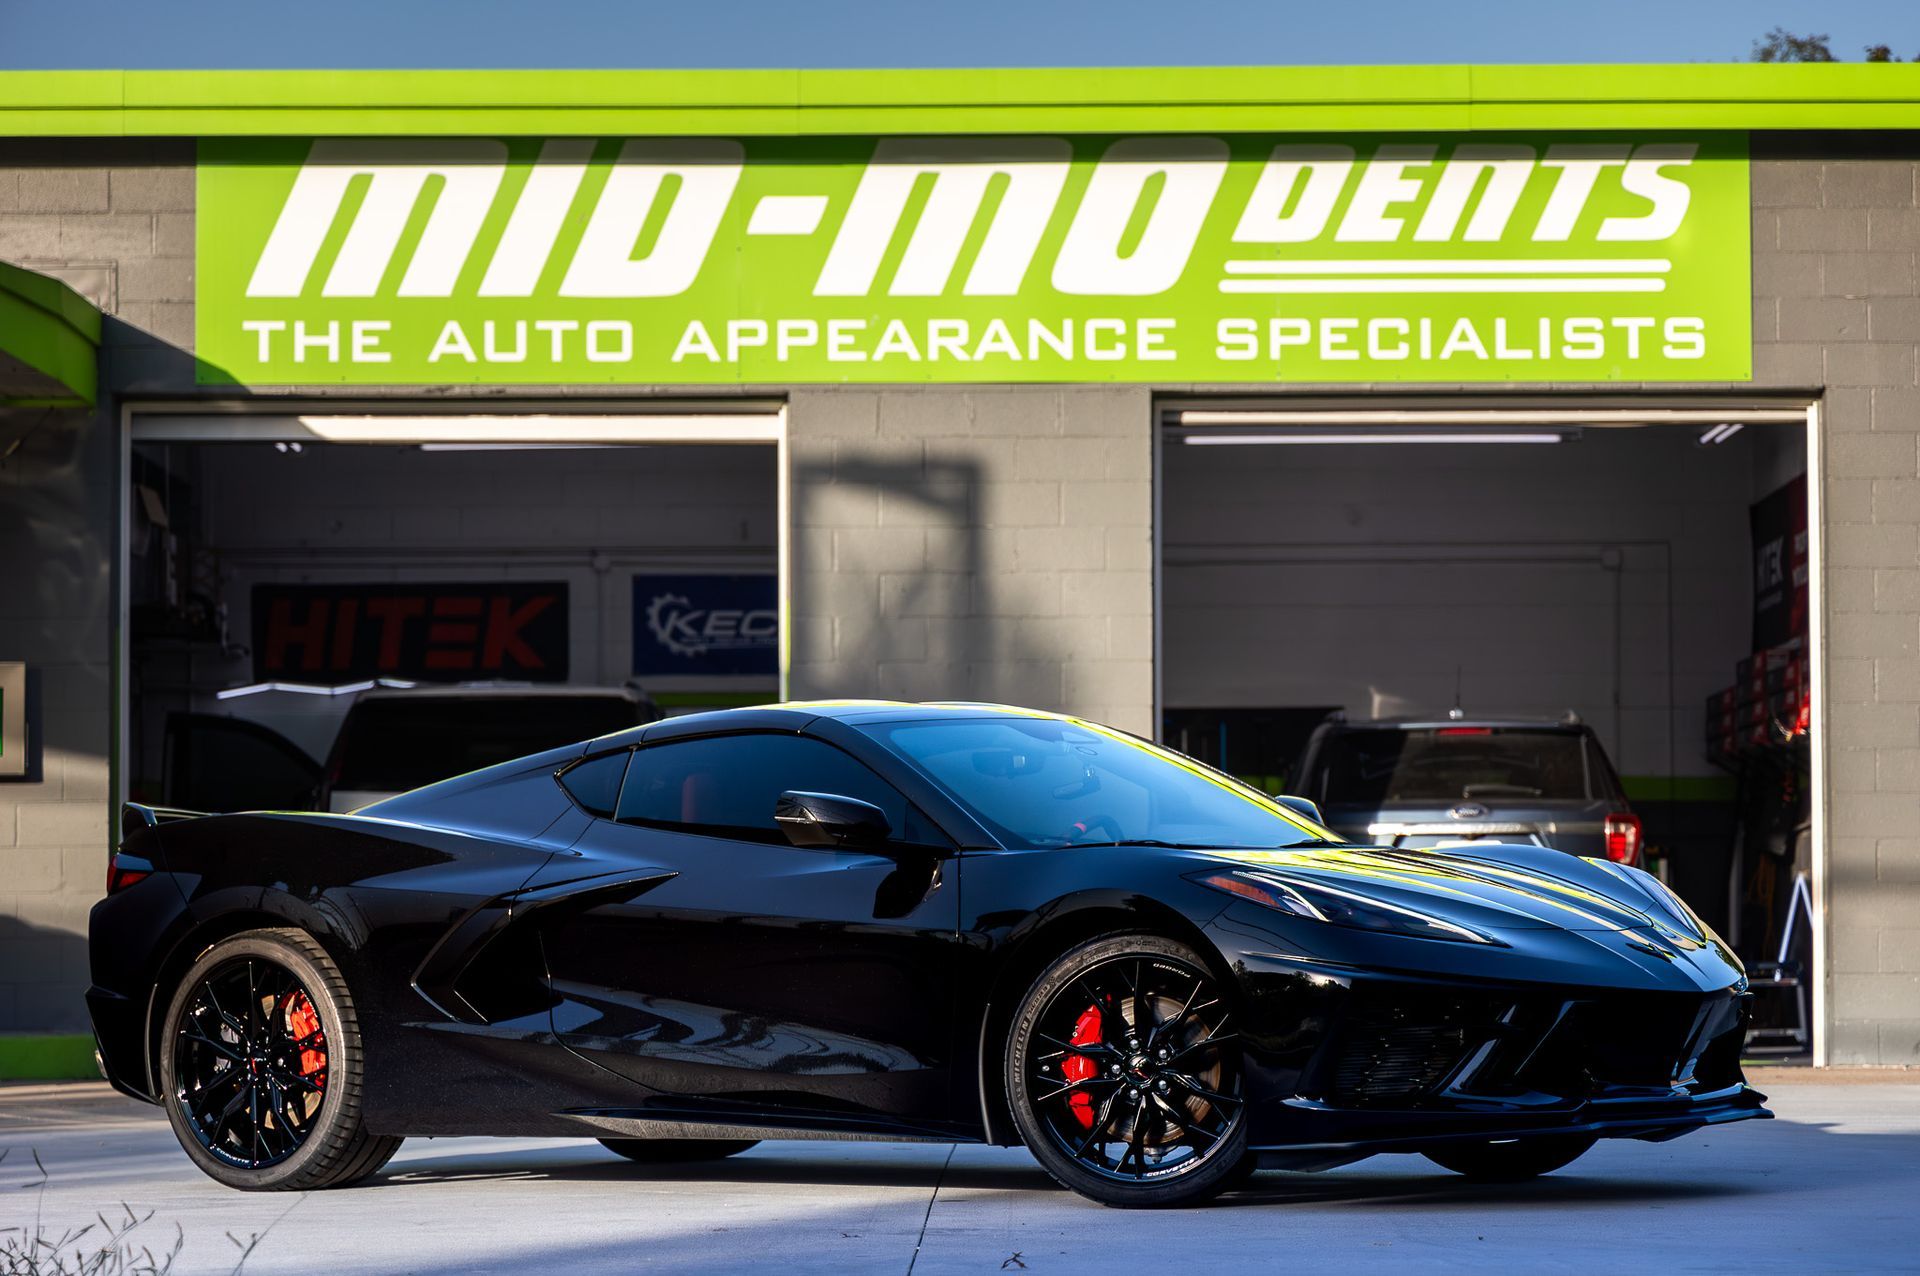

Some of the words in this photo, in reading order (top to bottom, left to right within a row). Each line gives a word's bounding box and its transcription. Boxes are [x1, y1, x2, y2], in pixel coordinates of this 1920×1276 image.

[245, 138, 1230, 298] MID-MO
[1231, 143, 1700, 243] DENTS
[242, 320, 392, 363] THE
[428, 320, 633, 363] AUTO
[671, 318, 1177, 363] APPEARANCE
[1215, 316, 1706, 361] SPECIALISTS
[265, 597, 557, 670] HITEK
[1014, 1020, 1029, 1083] MICHELIN
[1146, 1156, 1199, 1177] CORVETTE
